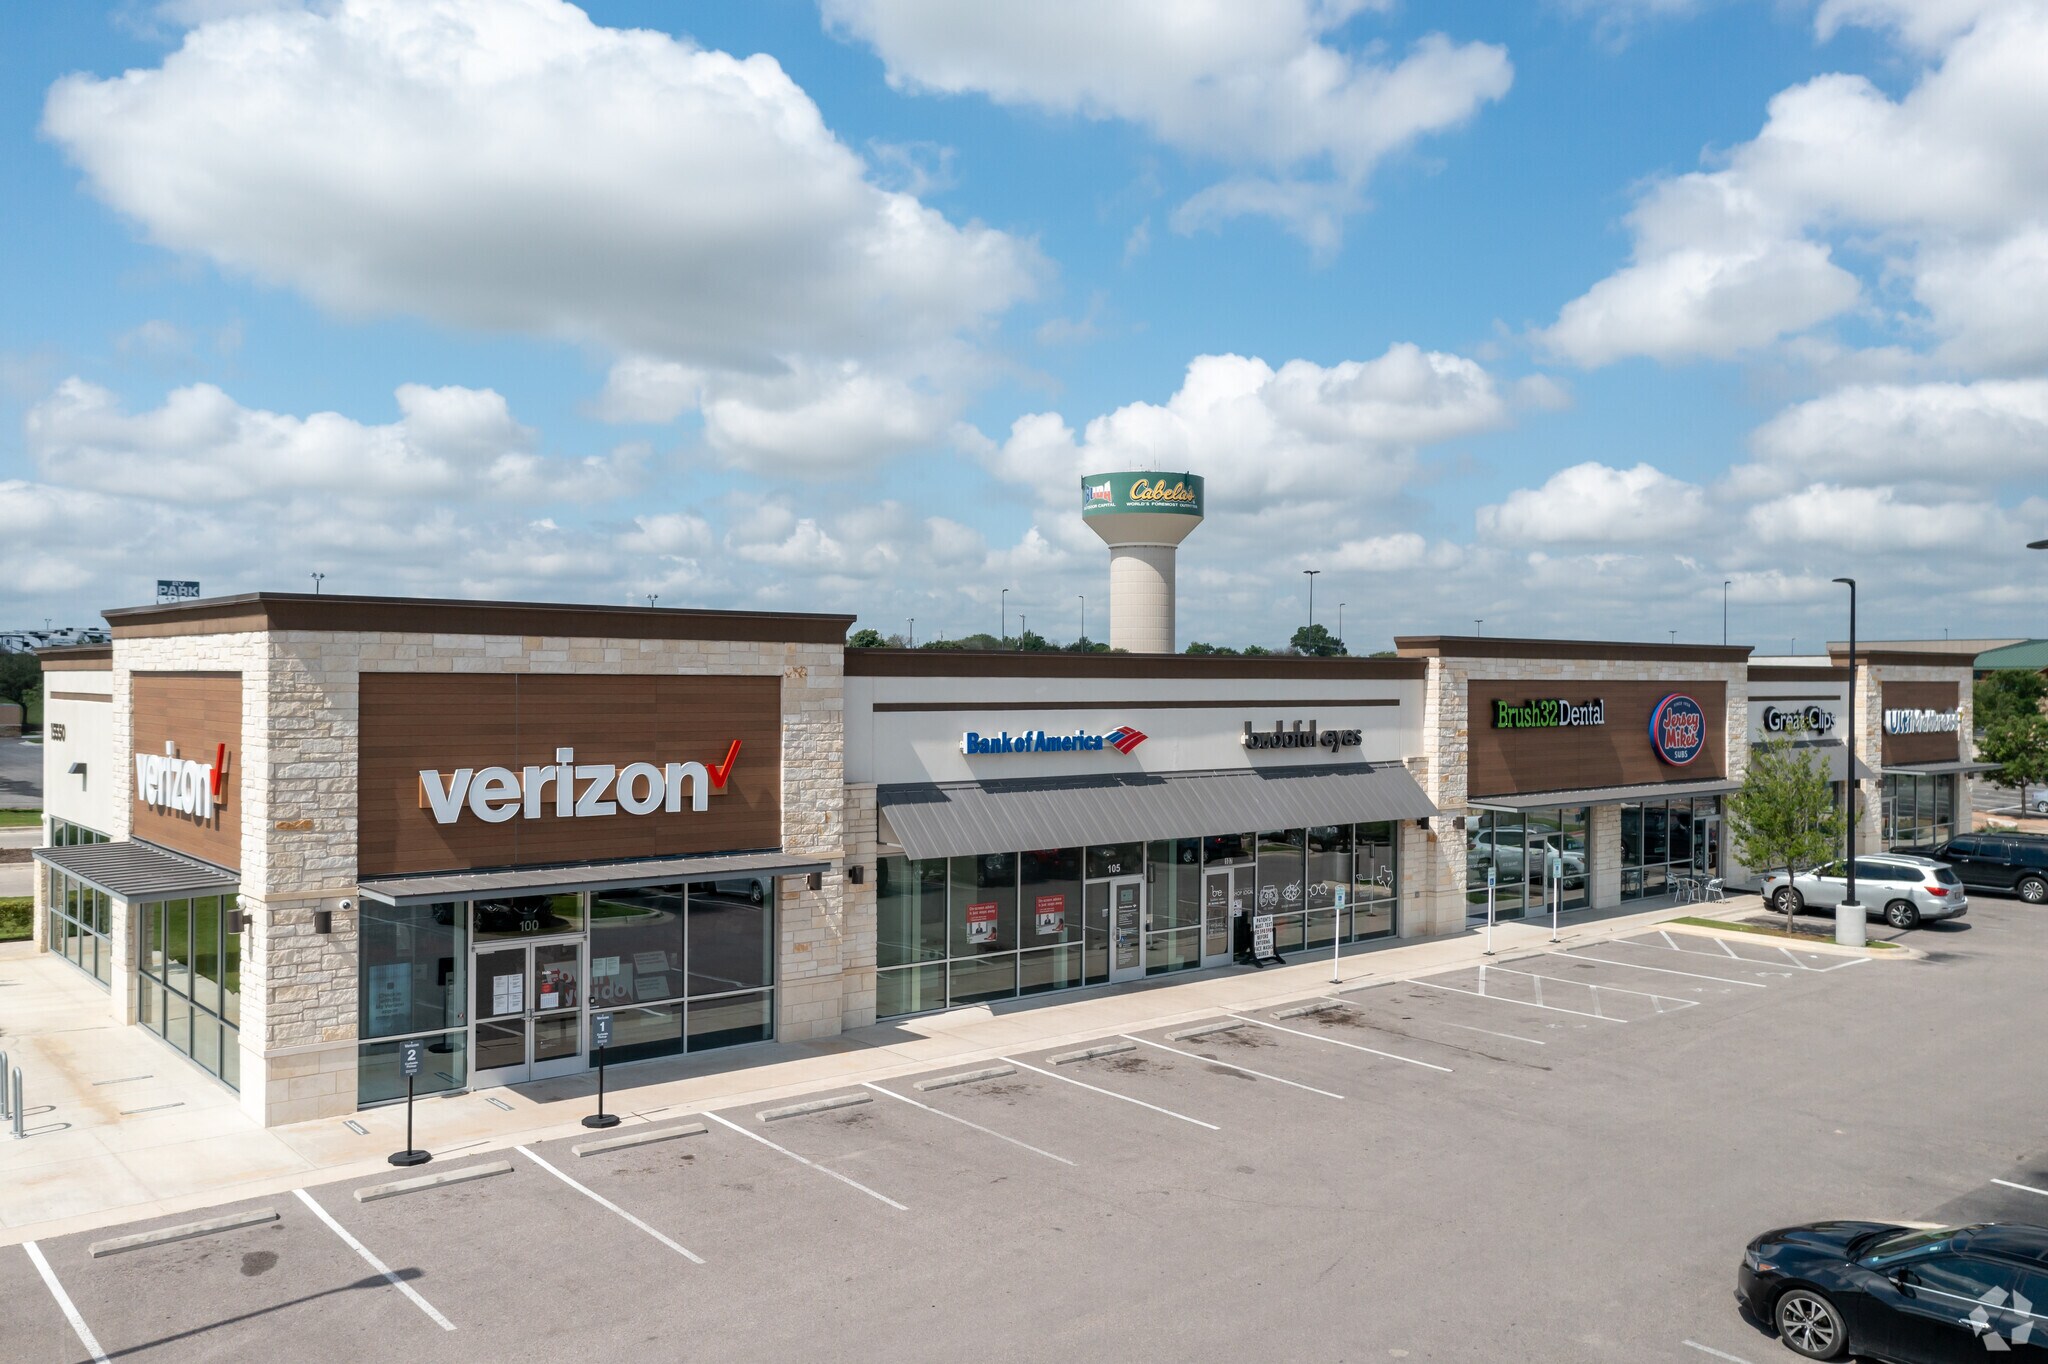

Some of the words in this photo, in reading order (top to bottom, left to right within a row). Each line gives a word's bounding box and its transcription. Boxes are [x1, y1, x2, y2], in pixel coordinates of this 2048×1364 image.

[1129, 479, 1195, 502] Cabela's
[158, 585, 199, 596] PARK
[1663, 707, 1700, 732] Jersey
[1807, 706, 1836, 734] Clips
[964, 731, 1012, 754] Bank
[1013, 730, 1033, 752] of
[1034, 729, 1103, 751] America
[1320, 729, 1362, 753] eyes
[1664, 729, 1698, 749] Mike's
[1674, 750, 1688, 759] SUBS
[135, 740, 214, 819] verizon
[419, 747, 708, 824] verizon
[1107, 863, 1121, 874] 105
[519, 919, 539, 931] 100
[600, 1021, 605, 1032] 1
[407, 1049, 416, 1061] 2
